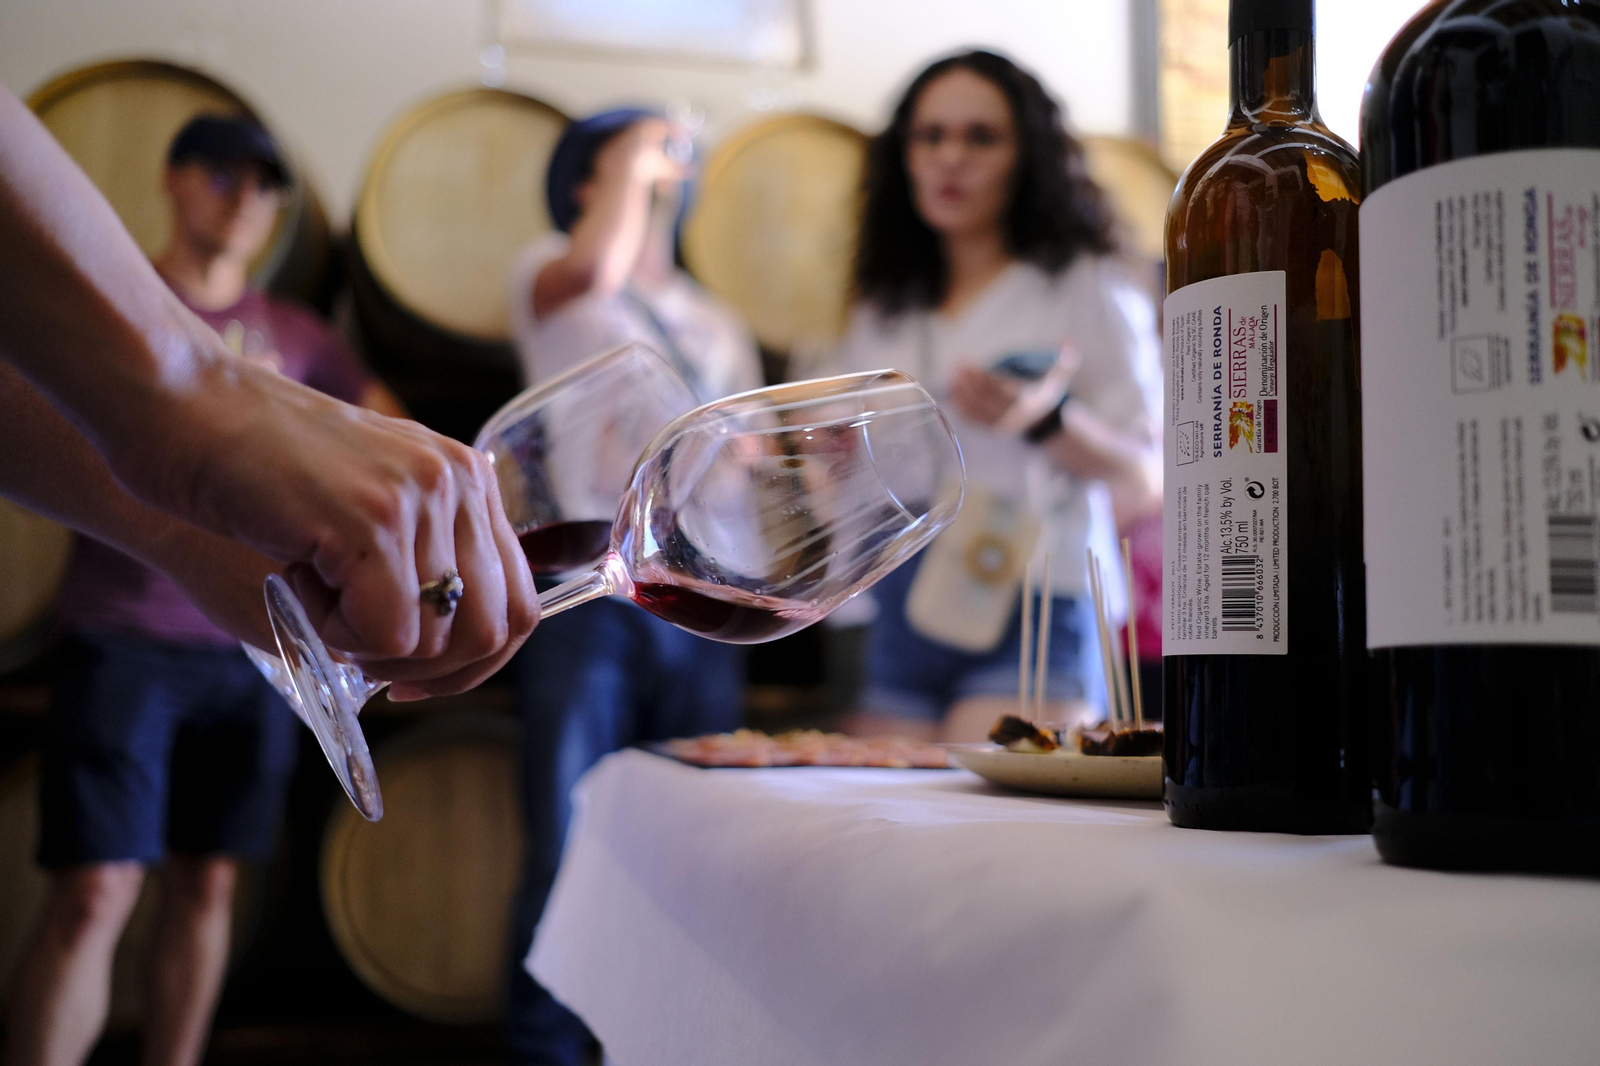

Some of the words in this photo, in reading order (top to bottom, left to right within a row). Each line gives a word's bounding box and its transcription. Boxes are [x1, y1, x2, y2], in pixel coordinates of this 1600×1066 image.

[1525, 262, 1540, 284] DE
[1238, 316, 1246, 325] de
[1258, 305, 1269, 330] Origen
[1213, 306, 1222, 357] RONDA
[1259, 332, 1267, 341] de
[1213, 362, 1222, 380] DE
[1233, 327, 1246, 398] SIERRAS
[1259, 343, 1268, 396] Denominación
[1211, 384, 1222, 458] SERRANÍA
[1182, 486, 1187, 494] de
[1220, 477, 1232, 494] Vol.
[1220, 497, 1235, 507] by
[1177, 511, 1181, 519] de
[1197, 519, 1202, 527] on
[1235, 521, 1248, 532] ml
[1235, 536, 1248, 554] 750
[1182, 564, 1187, 572] de
